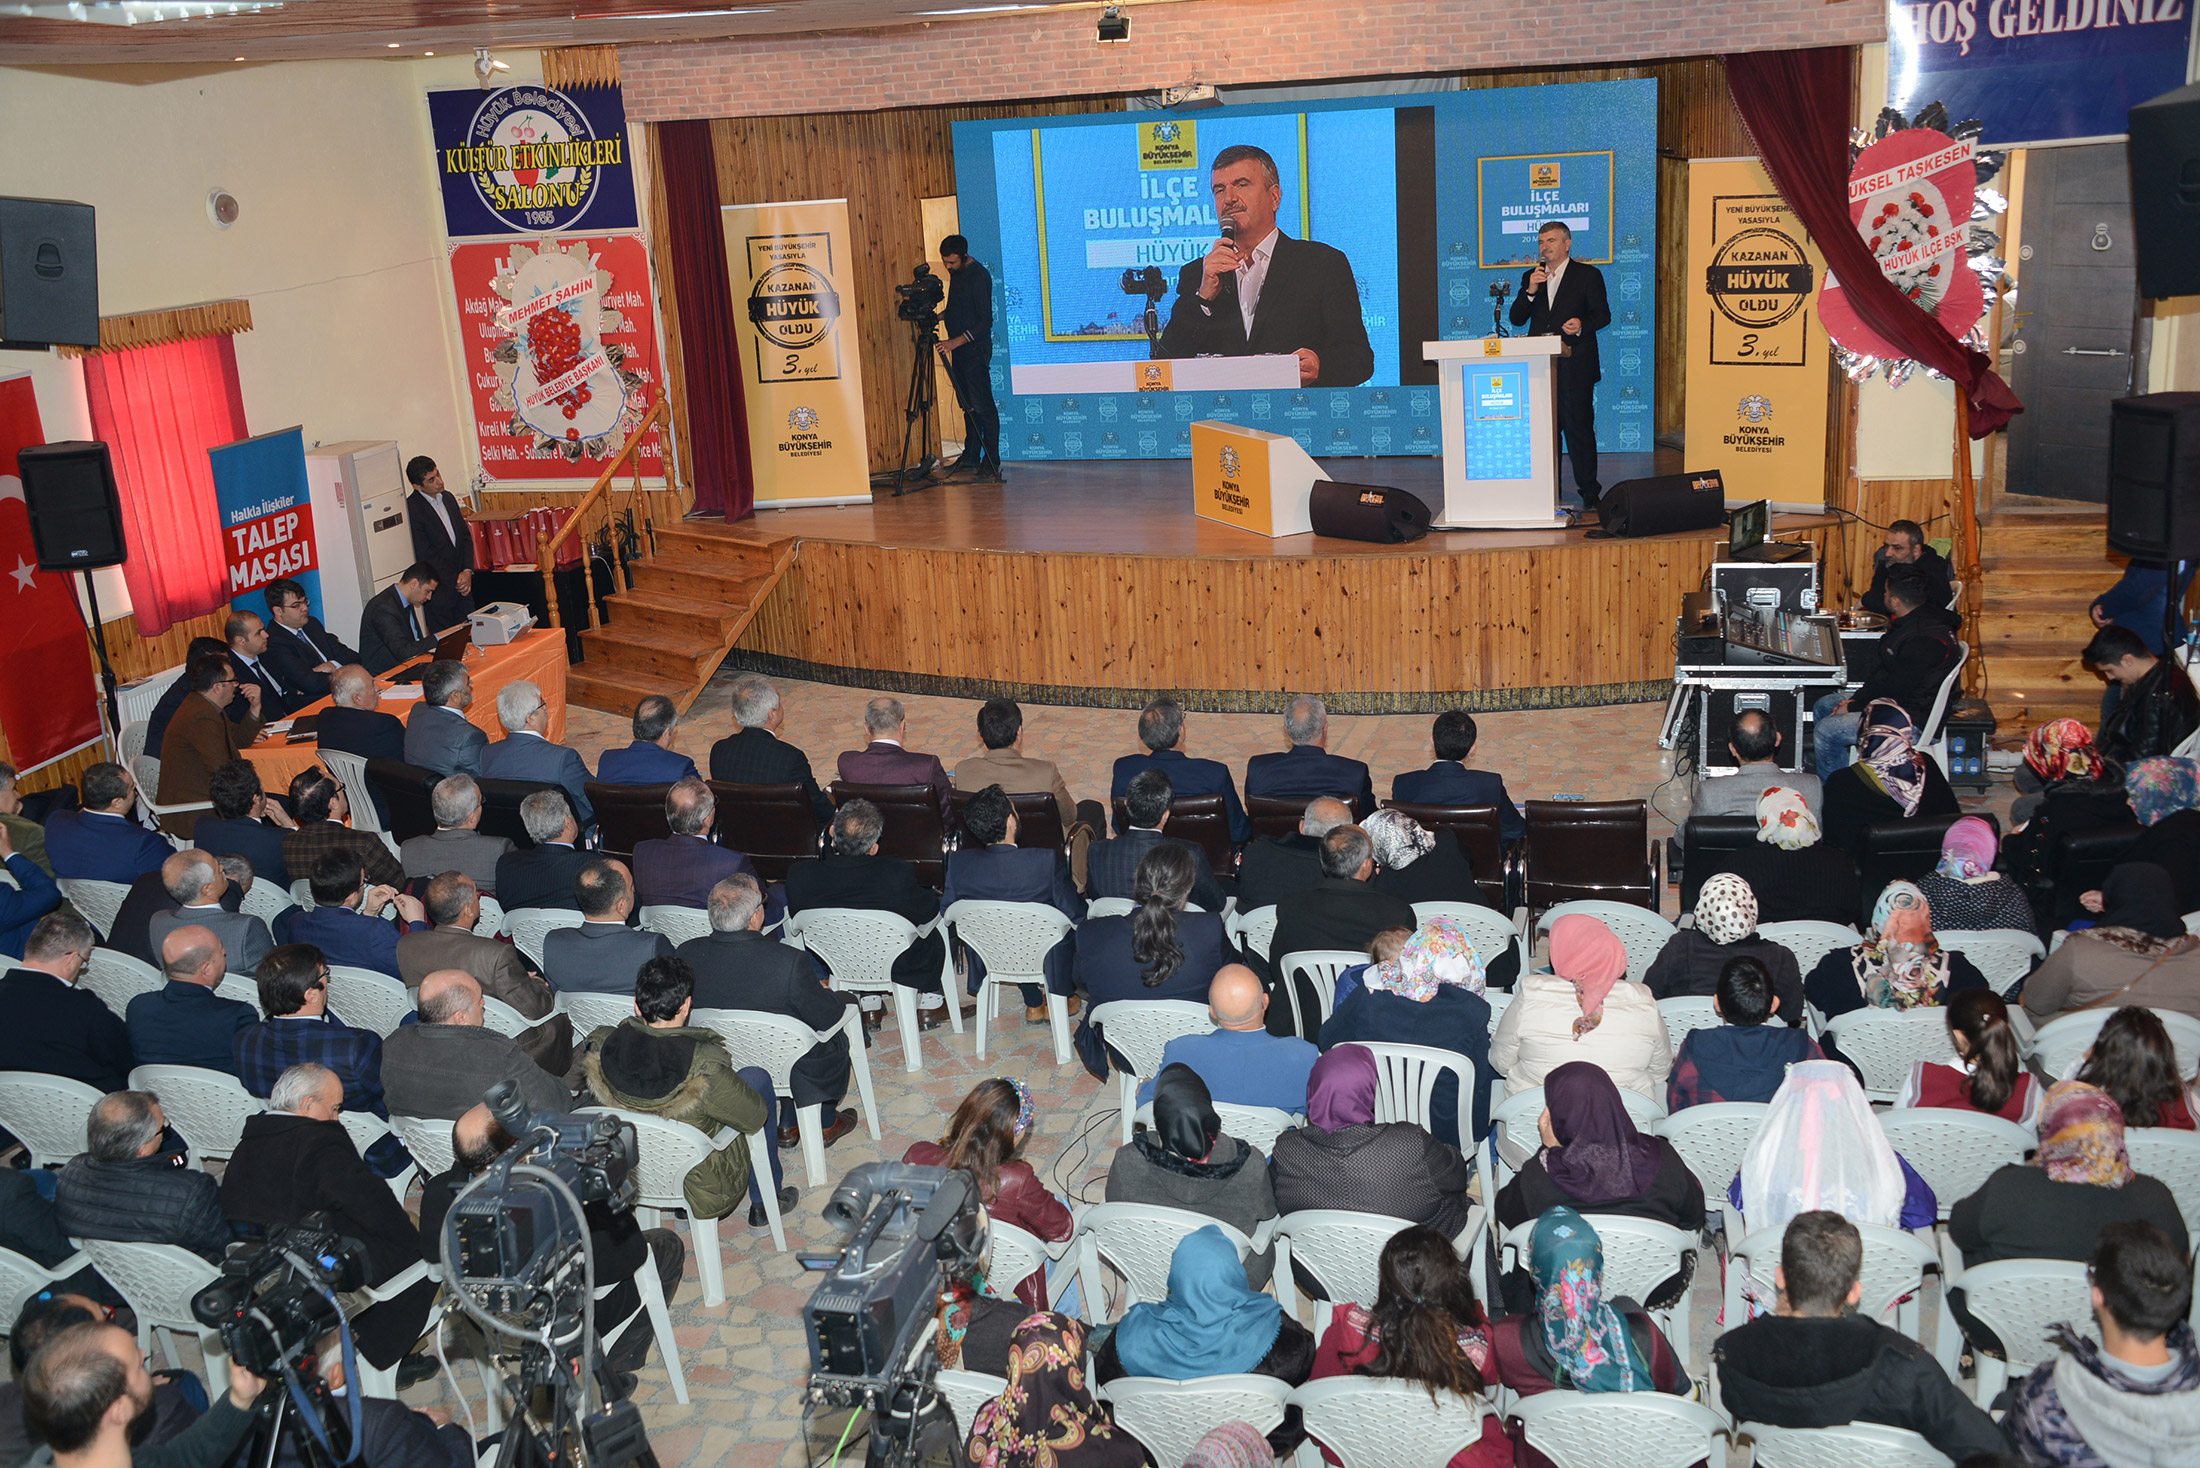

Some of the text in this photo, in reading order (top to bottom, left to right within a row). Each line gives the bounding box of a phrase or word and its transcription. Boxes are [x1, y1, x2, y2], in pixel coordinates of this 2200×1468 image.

[475, 90, 585, 138] Hüyük Belediyesi
[446, 131, 622, 173] KÜLTÜR ETKİNLİKLERİ
[1849, 143, 1970, 199] ÜKSEL TAŞKESEN
[494, 180, 581, 210] SALONU
[1140, 172, 1199, 206] İLÇE
[1530, 189, 1560, 204] İLÇE
[524, 210, 555, 225] 1955
[1501, 202, 1589, 218] BULUŞMALARI
[1725, 204, 1743, 214] YENİ
[1083, 204, 1219, 234] BULUŞMAL
[1737, 216, 1781, 225] YASASIYLA
[757, 243, 773, 252] YENİ
[1884, 229, 1964, 272] HÜYÜK İLÇE BŞK
[769, 252, 806, 261] YASASIYLA
[1731, 251, 1788, 262] KAZANAN
[767, 281, 817, 293] KAZANAN
[1727, 269, 1790, 289] HÜYÜK
[465, 297, 488, 317] Akdağ
[508, 277, 593, 324] MEHMET ŞAHİN
[625, 290, 645, 308] Mah.
[766, 298, 820, 317] HÜYÜK
[1739, 299, 1779, 312] OLDU
[779, 323, 813, 335] OLDU
[526, 390, 546, 408] HÜYÜK
[545, 376, 573, 398] BELEDİYE
[573, 354, 605, 382] BAŞKANI
[478, 420, 500, 437] Kıreli
[791, 433, 818, 441] KONYA
[1739, 426, 1770, 435] KONYA
[778, 439, 832, 452] BÜYÜKŞEHİR
[1723, 434, 1785, 447] BÜYÜKŞEHİR
[481, 444, 501, 461] Selki
[501, 444, 520, 460] Mah.
[790, 450, 822, 458] BELEDİYESİ
[1221, 480, 1241, 493] KONYA
[1214, 488, 1250, 509] BÜYÜKŞEHİR
[231, 495, 295, 524] Halkla İlişkiler
[1221, 503, 1243, 515] BELEDİYESİ
[232, 512, 299, 556] TALEP
[229, 540, 311, 592] MASASI
